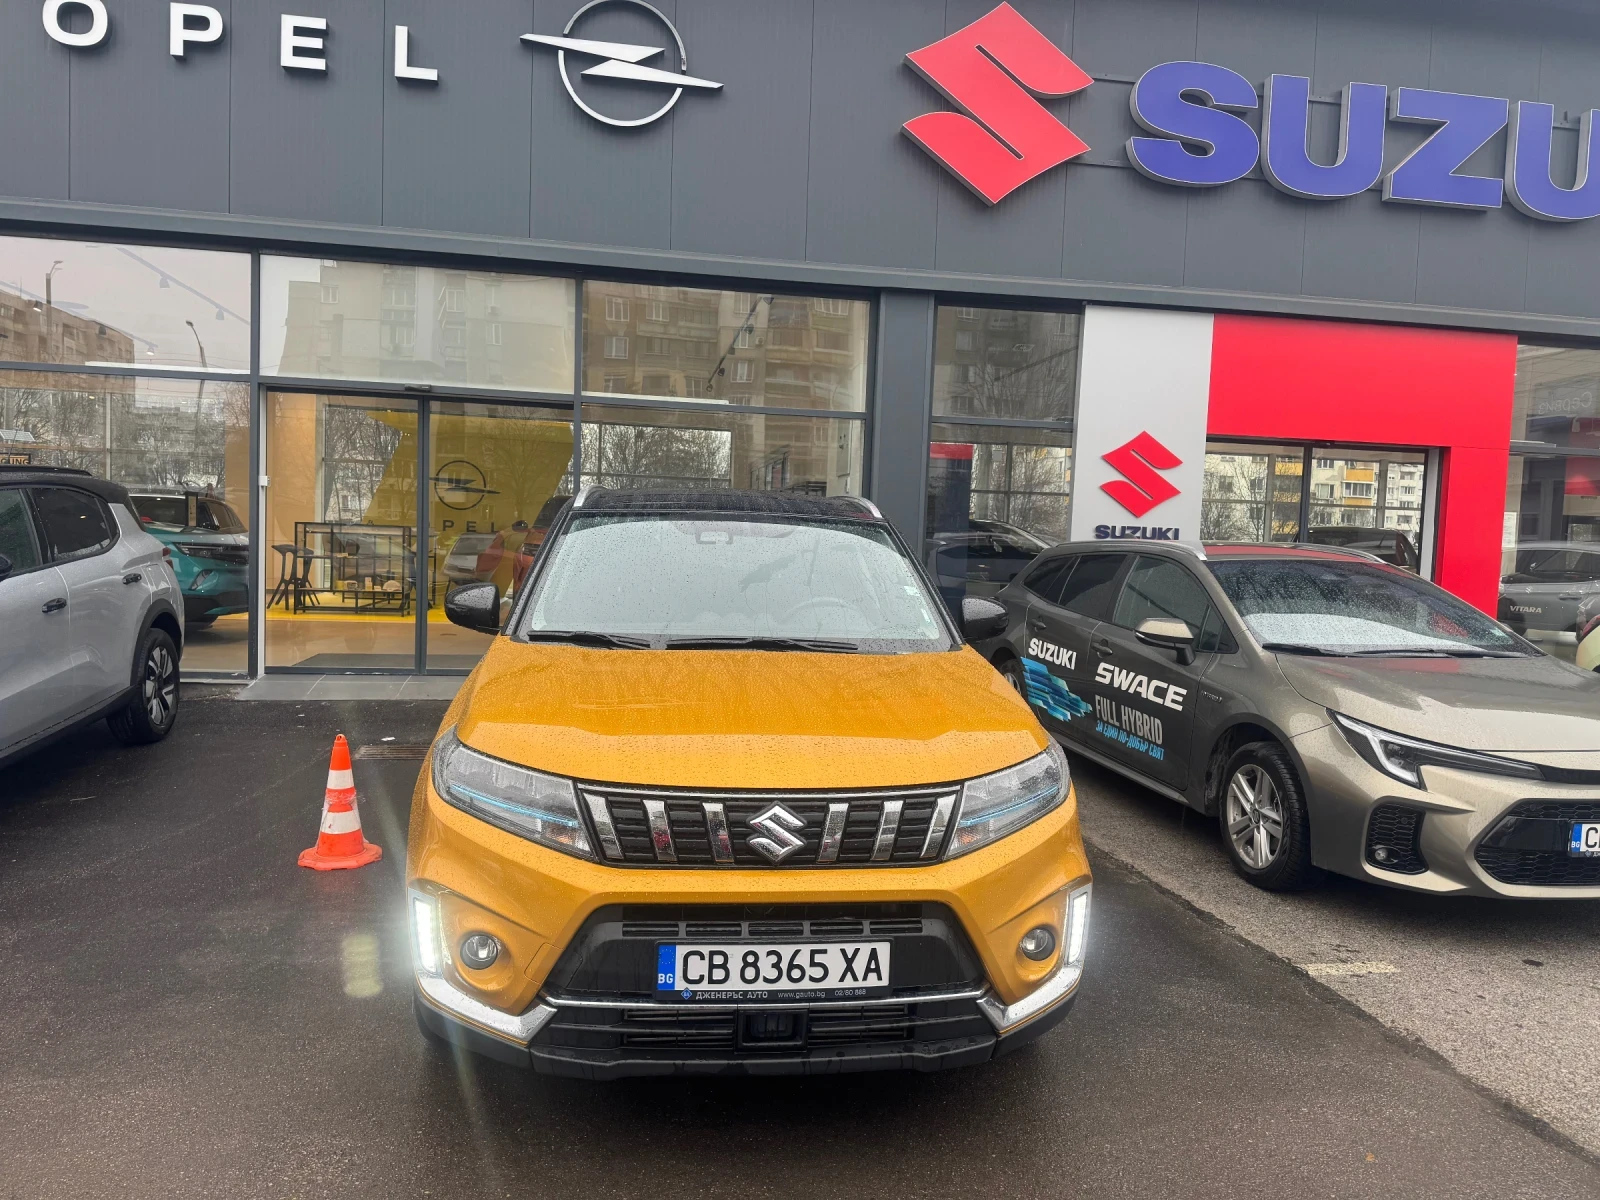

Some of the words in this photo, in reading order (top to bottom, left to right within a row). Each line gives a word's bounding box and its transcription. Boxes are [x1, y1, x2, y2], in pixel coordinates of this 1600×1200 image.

[42, 0, 438, 82] OPEL
[1126, 60, 1600, 221] SUZU
[428, 519, 499, 532] PEL
[1095, 524, 1180, 541] SUZUKI
[1510, 605, 1542, 613] VITARA
[1028, 637, 1077, 670] SUZUKI
[1095, 662, 1187, 712] SWACE
[1095, 694, 1120, 727] FULL
[1121, 704, 1163, 745] HYBRID
[1103, 723, 1119, 739] ЕДИН
[1585, 826, 1600, 849] C
[682, 950, 730, 985] CB
[739, 948, 830, 985] 8365
[838, 947, 883, 983] XA
[657, 973, 674, 984] BG
[695, 991, 743, 1000] ДЖЕНЕРЪС
[747, 991, 768, 999] АУТО
[777, 990, 826, 999] www.gauto.bg
